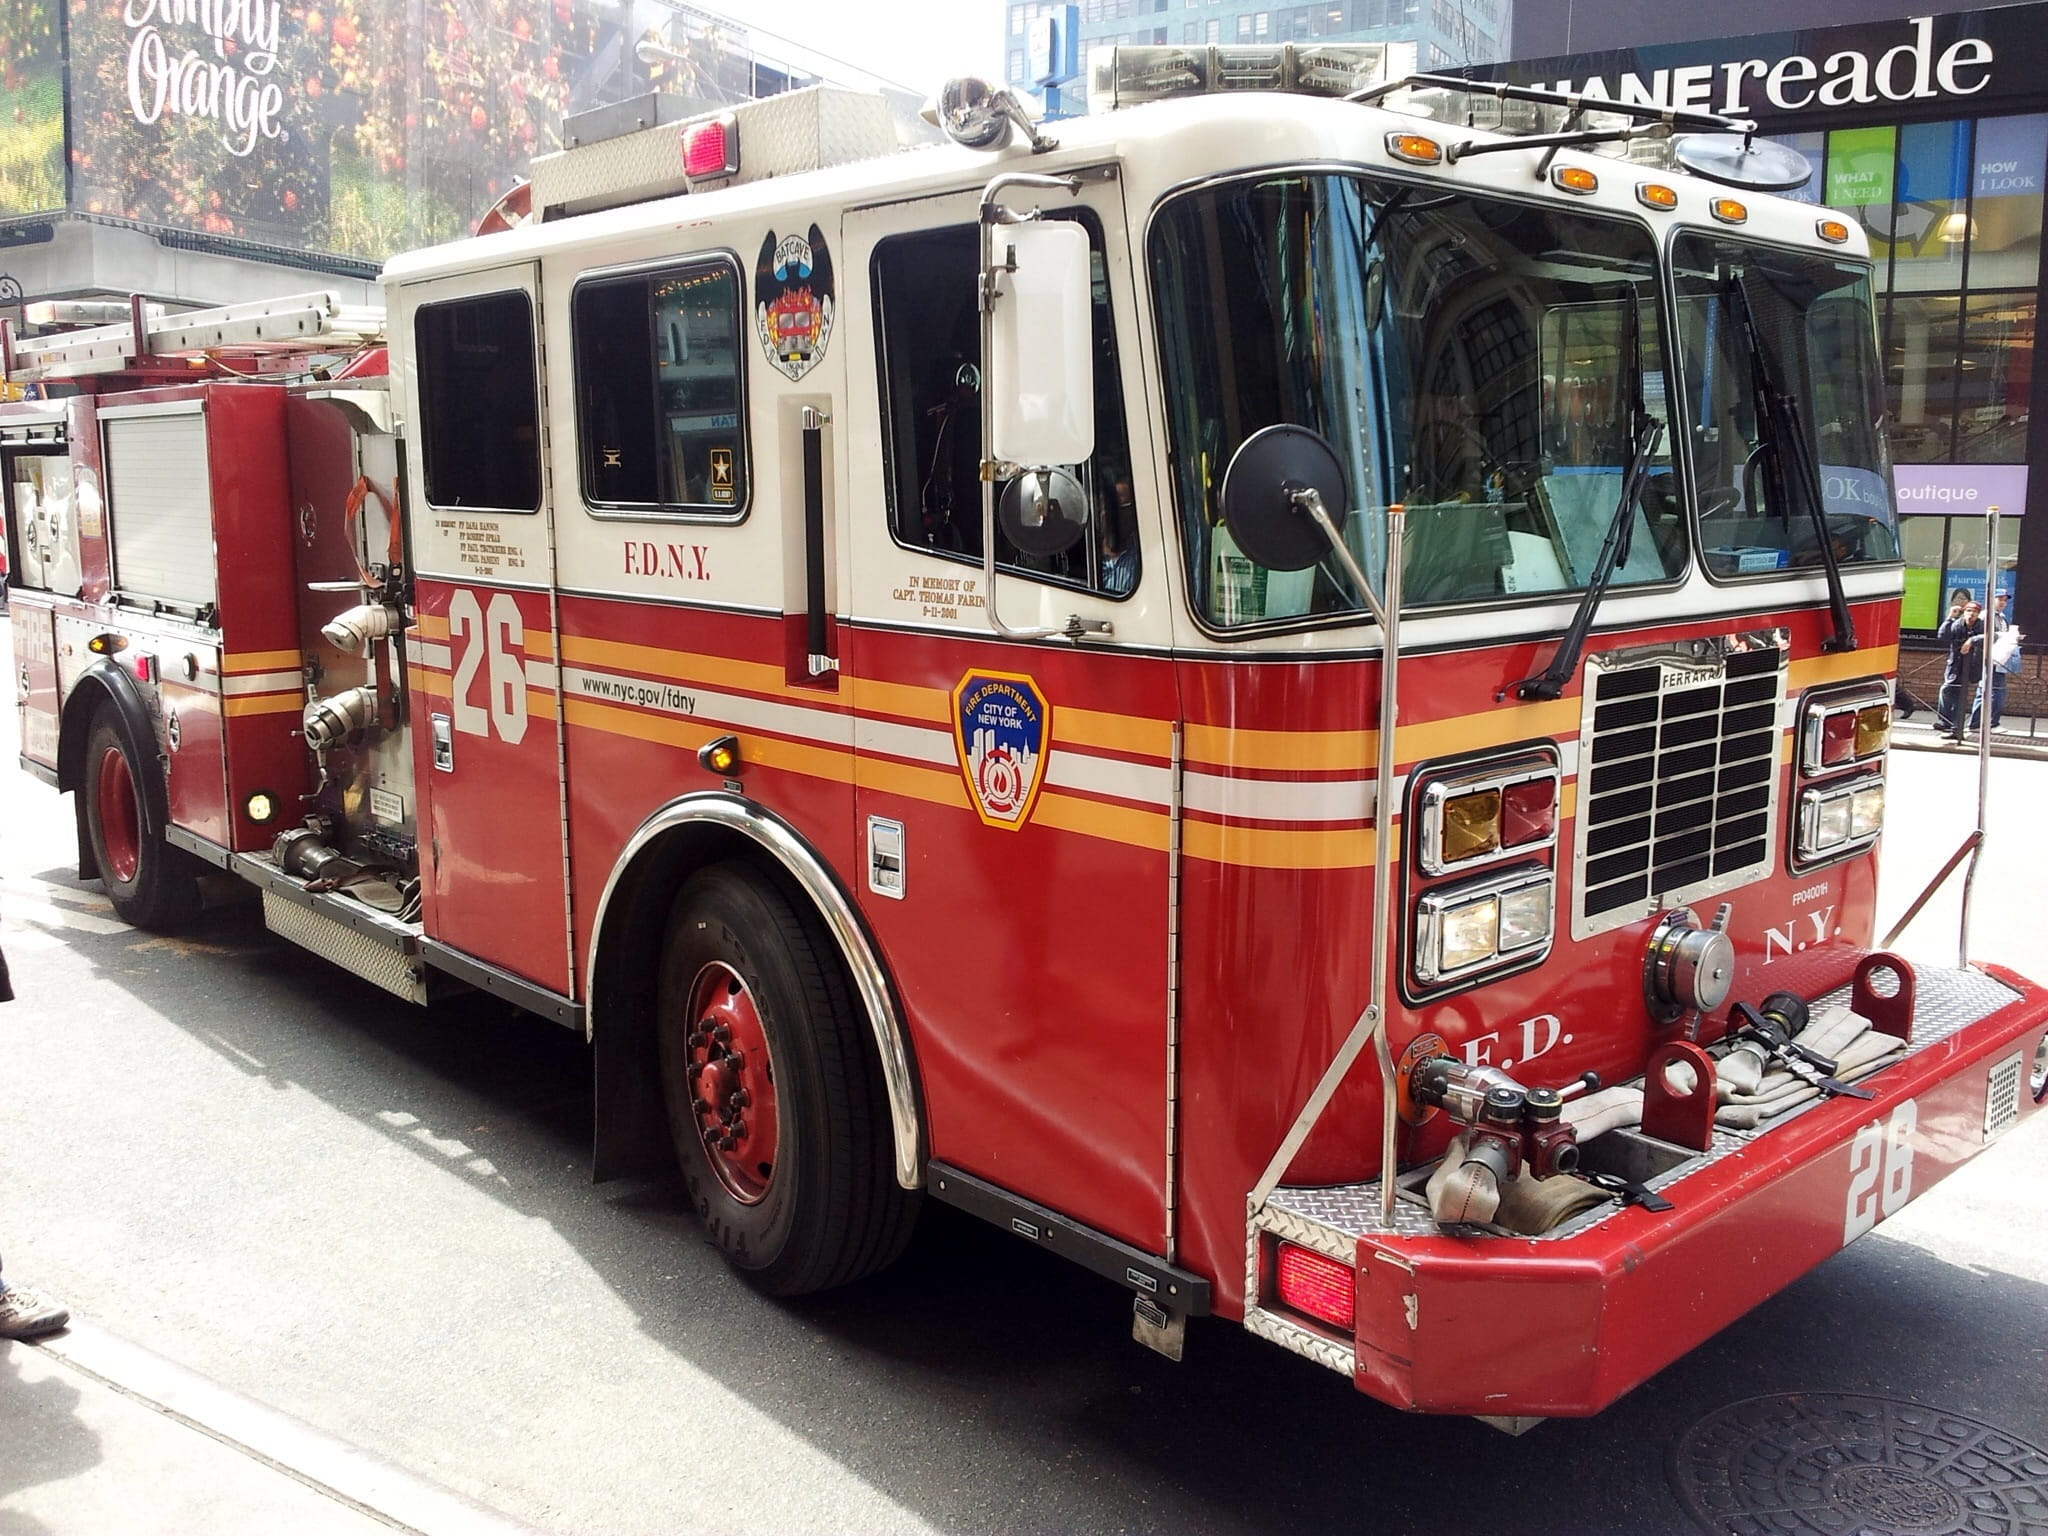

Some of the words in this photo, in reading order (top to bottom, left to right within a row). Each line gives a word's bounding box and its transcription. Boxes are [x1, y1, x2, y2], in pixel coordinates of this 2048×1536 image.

[128, 26, 282, 157] Orange
[1981, 161, 2018, 175] HOW
[1834, 172, 1875, 185] WHAT
[1991, 176, 2036, 190] LOOK
[1844, 186, 1883, 200] NEED
[775, 242, 809, 264] BATCAVE
[624, 541, 711, 581] F.D.N.Y.
[909, 576, 920, 588] IN
[922, 577, 961, 592] MEMORY
[963, 580, 976, 593] OF
[893, 588, 917, 602] CAPT.
[919, 591, 956, 605] THOMAS
[922, 606, 958, 620] 9-11-2001
[448, 588, 529, 745] 26
[582, 676, 696, 715] www.nyc.gov/fdny
[965, 691, 982, 717] FIRE
[981, 683, 1037, 723] DEPARTMENT
[983, 703, 1003, 716] CITY
[1004, 705, 1018, 718] OF
[978, 714, 998, 726] NEW
[998, 716, 1023, 731] YORK
[1842, 1097, 1918, 1248] 26
